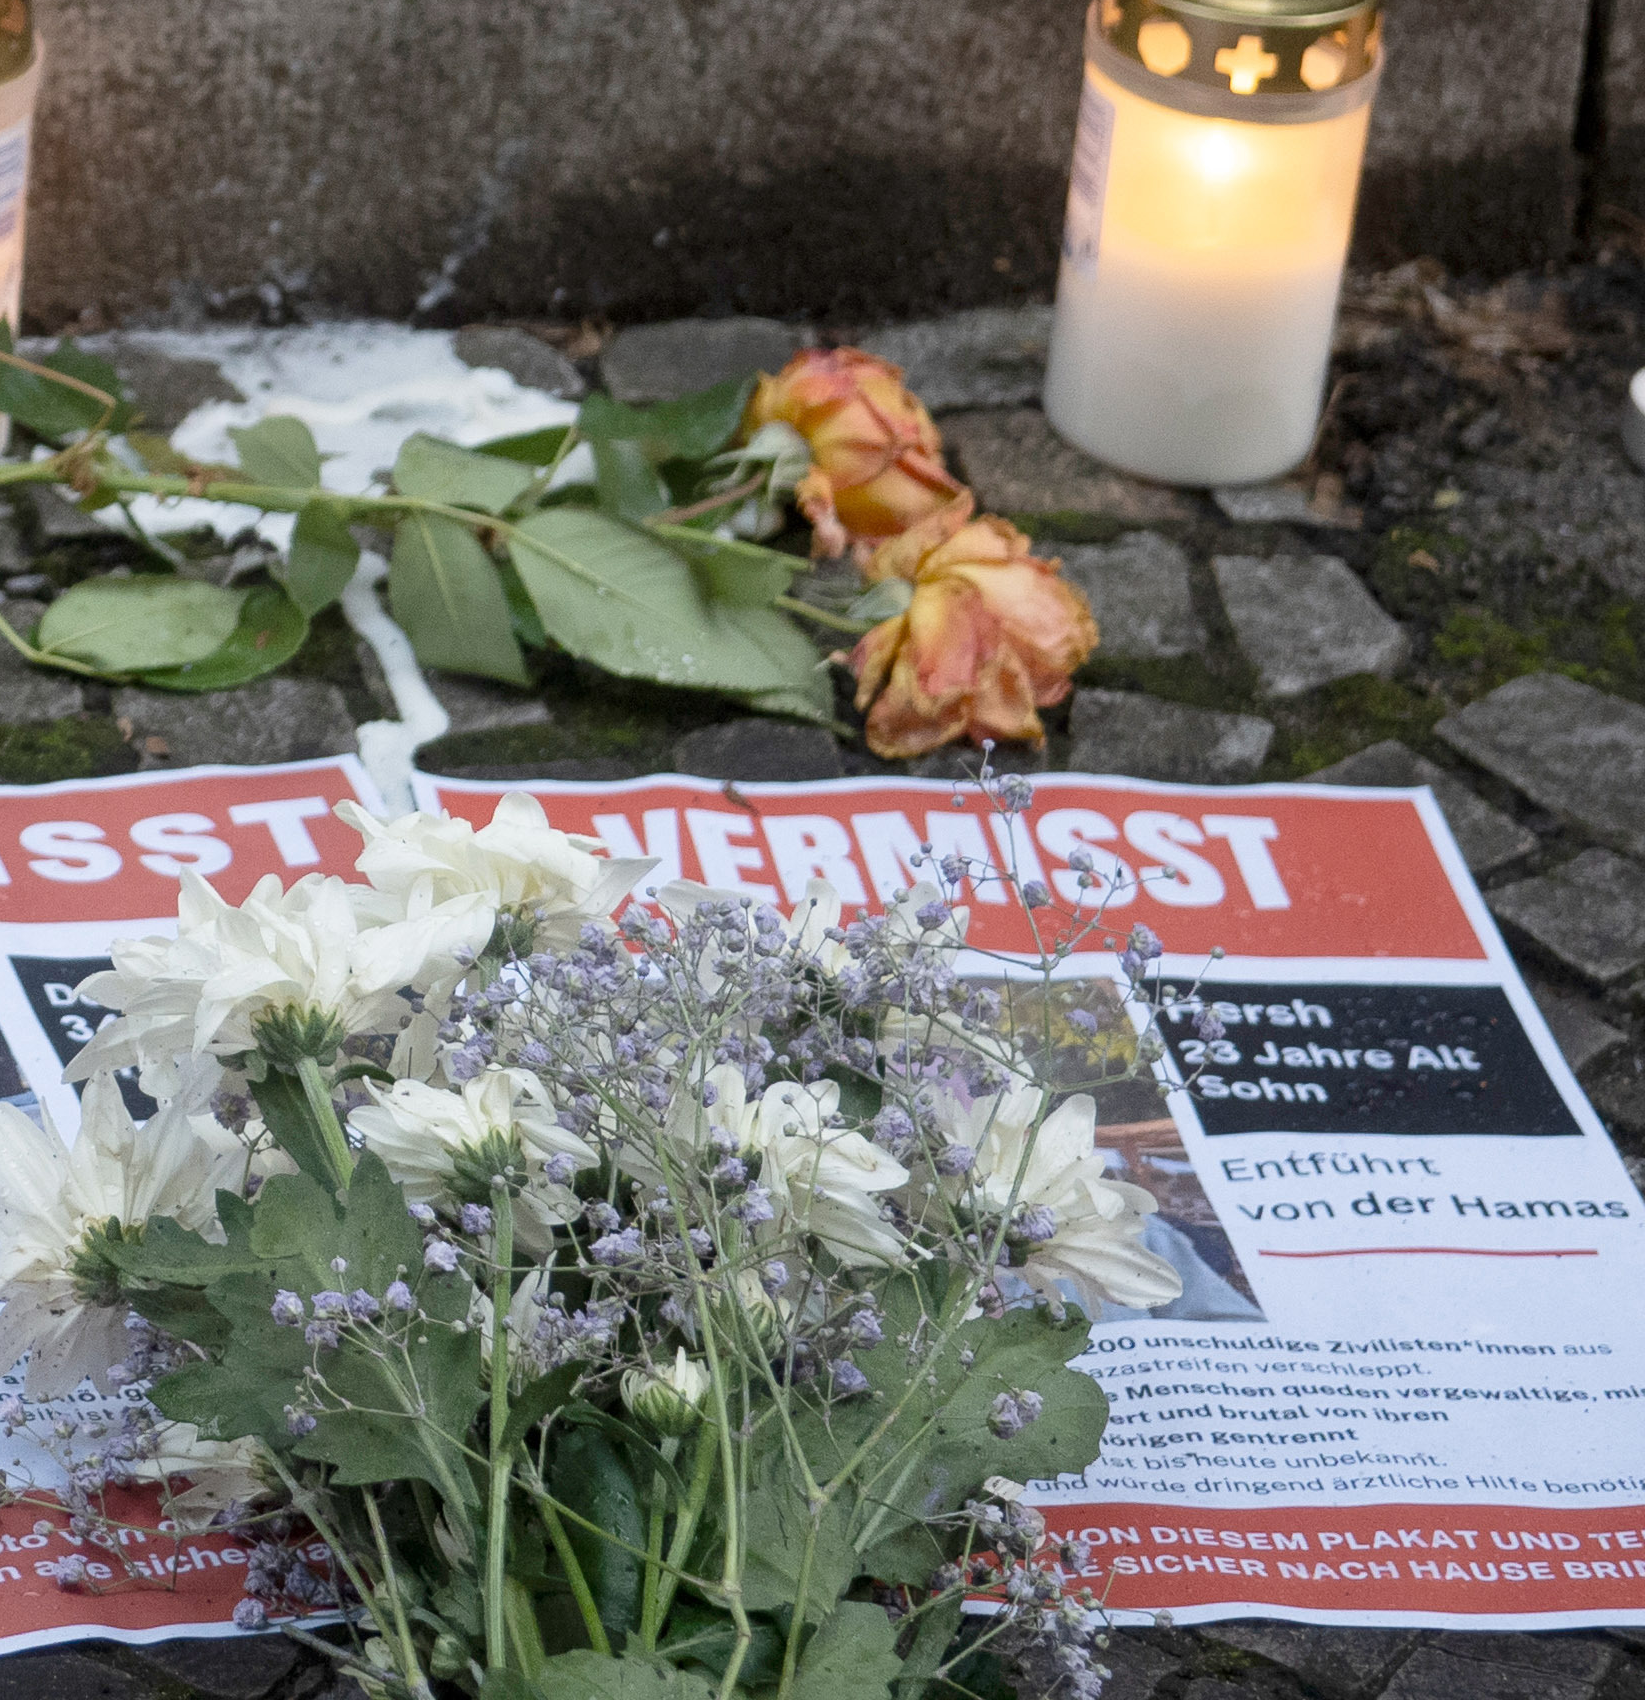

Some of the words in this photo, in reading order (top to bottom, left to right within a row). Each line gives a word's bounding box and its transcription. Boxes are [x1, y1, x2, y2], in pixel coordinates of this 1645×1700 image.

[593, 806, 1291, 912] VERMISST
[1178, 1038, 1242, 1066] 23
[1254, 1040, 1396, 1070] Jahre
[1407, 1043, 1483, 1072] Alt
[1196, 1074, 1329, 1103] Sohn
[1219, 1152, 1442, 1183] Entführt
[1236, 1199, 1336, 1222] von
[1349, 1190, 1435, 1218] der
[1449, 1188, 1632, 1220] Hamas
[1142, 1335, 1321, 1354] unschuldige
[1253, 1361, 1433, 1380] verschleppt.
[1124, 1381, 1277, 1402] Menschen
[1156, 1402, 1214, 1422] und
[1217, 1403, 1311, 1422] brutal
[1314, 1406, 1369, 1420] von
[1372, 1407, 1450, 1424] ihren
[1033, 1470, 1090, 1492] und
[1095, 1477, 1187, 1494] würde
[1193, 1476, 1326, 1496] dringend
[1332, 1472, 1460, 1492] ärztliche
[1316, 1528, 1479, 1552] PLAKAT
[1489, 1530, 1582, 1552] UND
[1111, 1553, 1270, 1579] SICHER
[1275, 1559, 1401, 1582] NACH
[1407, 1559, 1556, 1583] HAUSE
